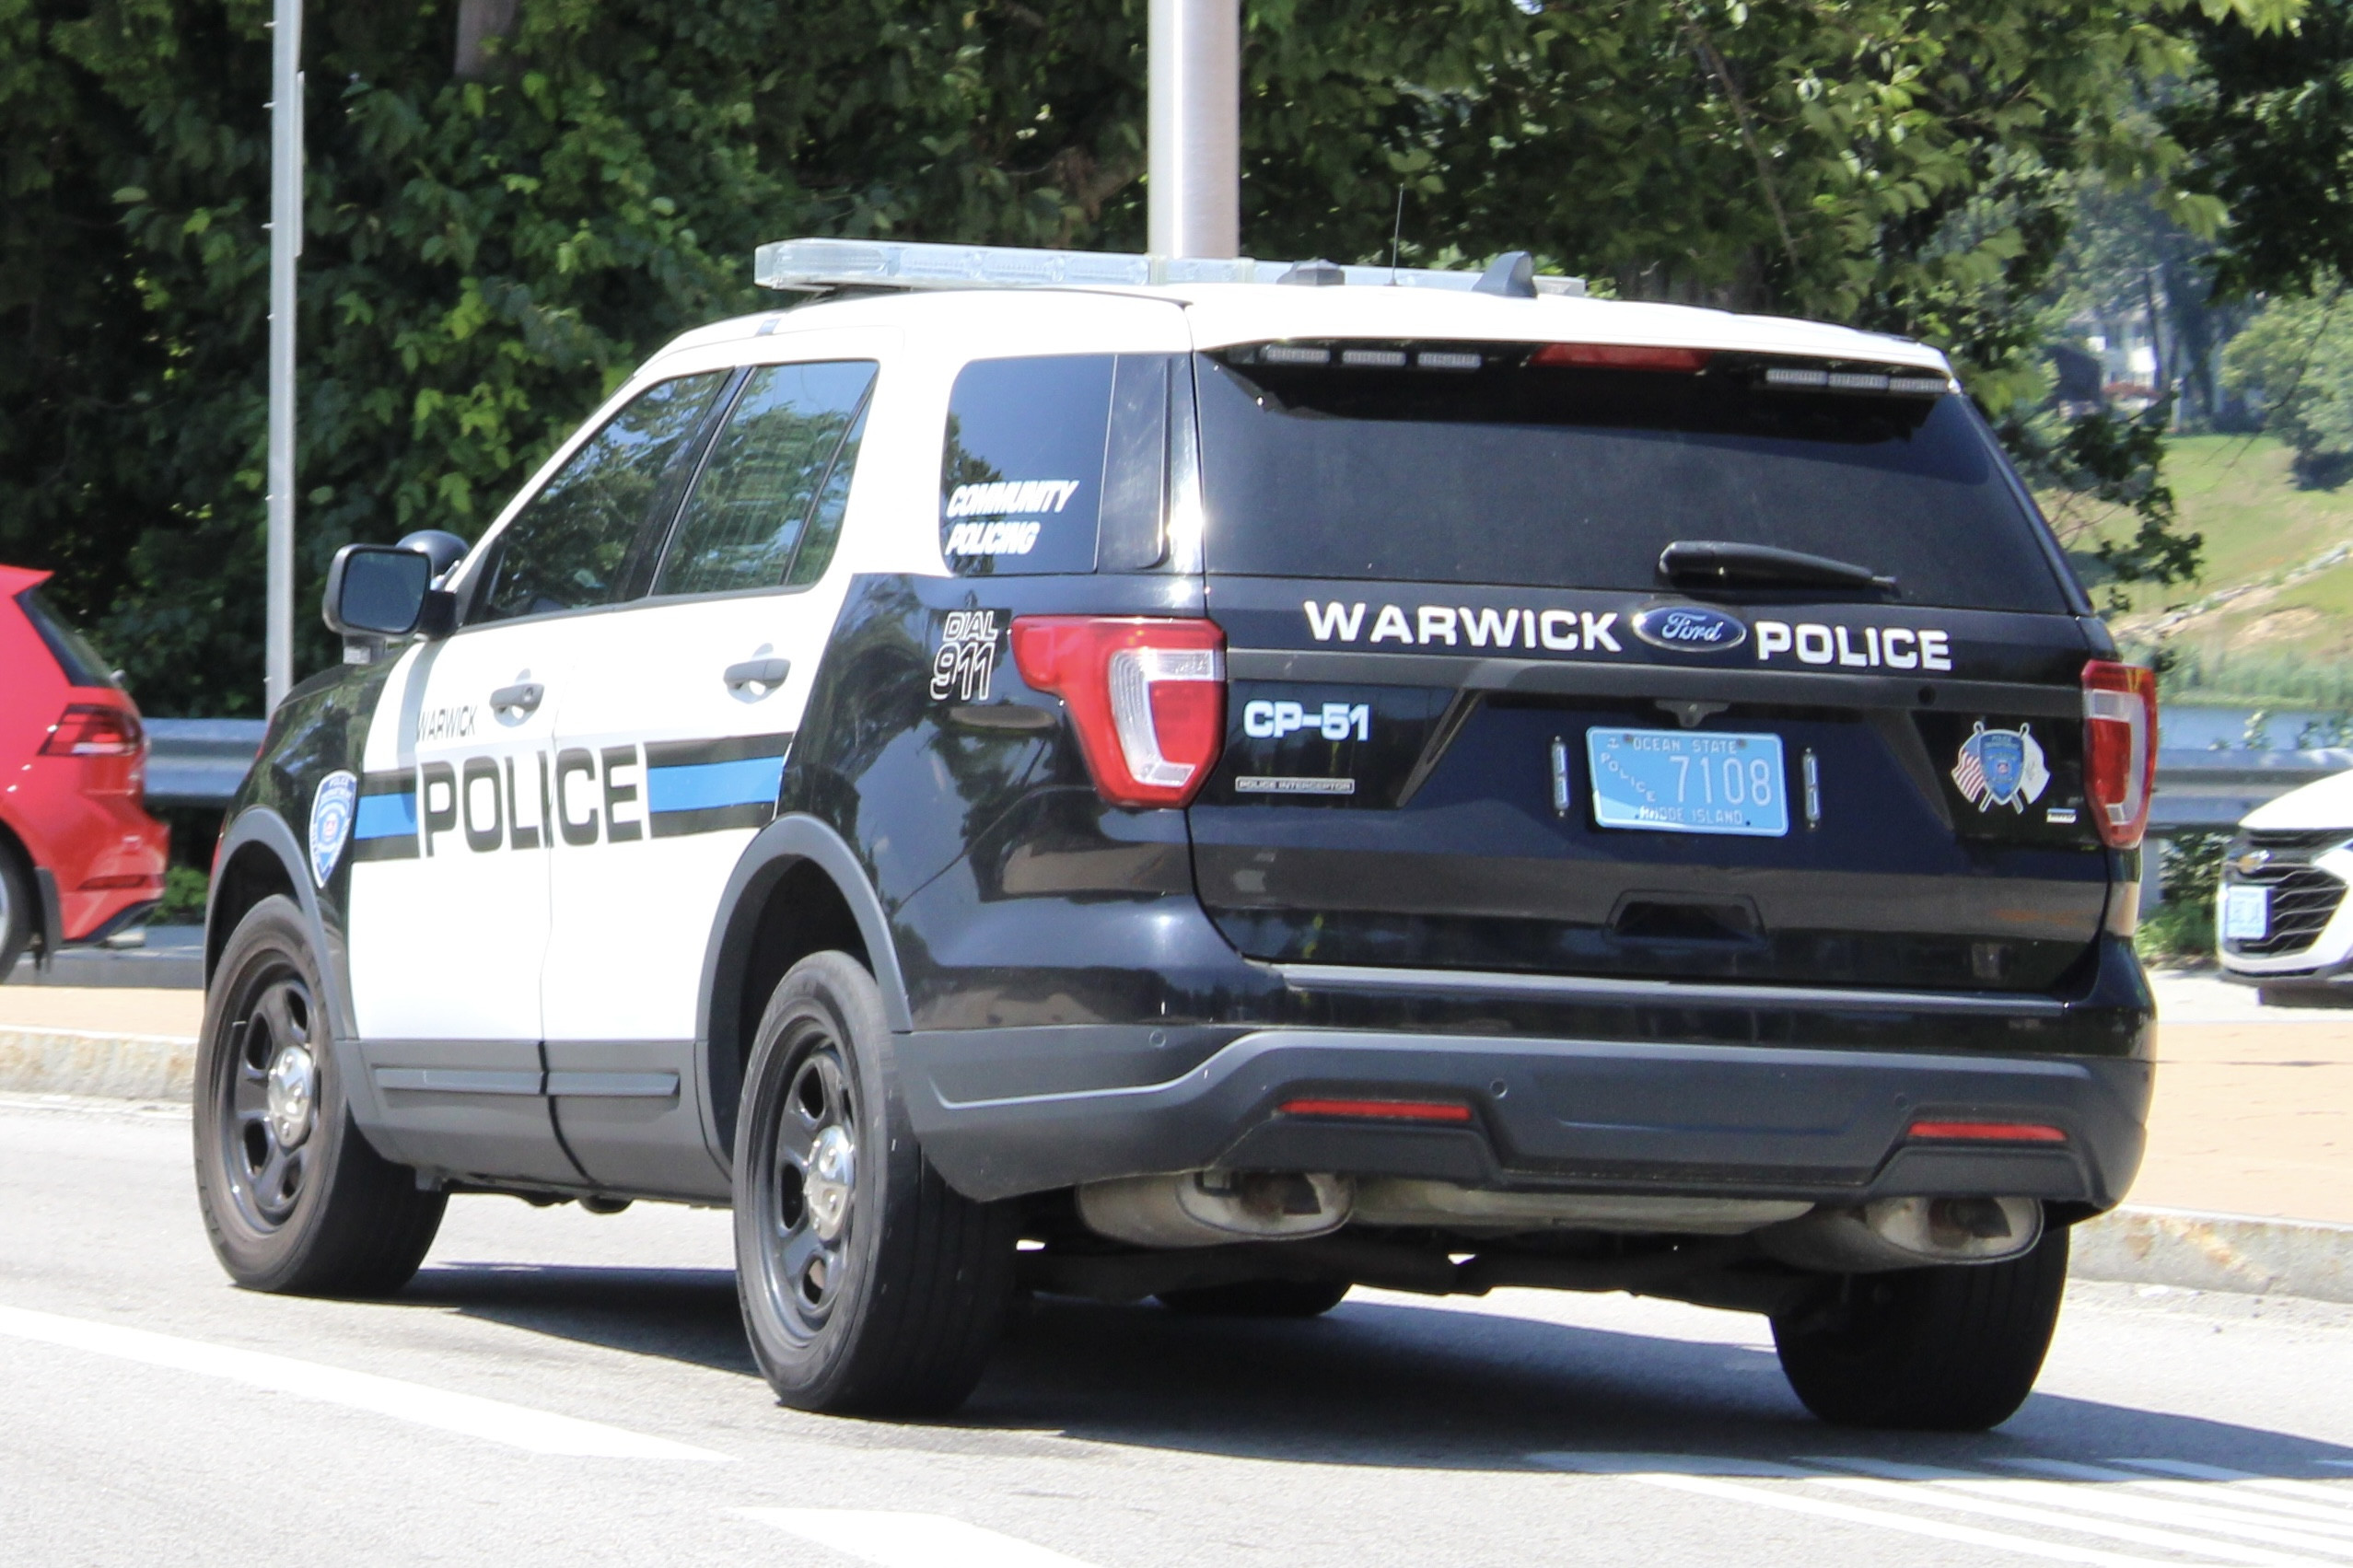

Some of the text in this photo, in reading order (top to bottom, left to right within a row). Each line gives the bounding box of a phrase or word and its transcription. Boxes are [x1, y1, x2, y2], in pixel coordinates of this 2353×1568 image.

[947, 481, 1079, 517] COMMUNITY
[945, 521, 1041, 555] POLICING
[942, 610, 998, 642] DIAL
[1303, 600, 1951, 671] WARWICK POLICE
[1661, 612, 1722, 642] Ford
[930, 642, 996, 701] 911
[417, 705, 477, 741] WARWICK
[1244, 700, 1369, 741] CP-51
[1633, 738, 1737, 754] OCEAN STATE
[1601, 752, 1656, 802] POLICE
[1669, 755, 1772, 807] 7108
[420, 744, 643, 857] POLICE
[1639, 805, 1742, 824] RHODE ISLAND
